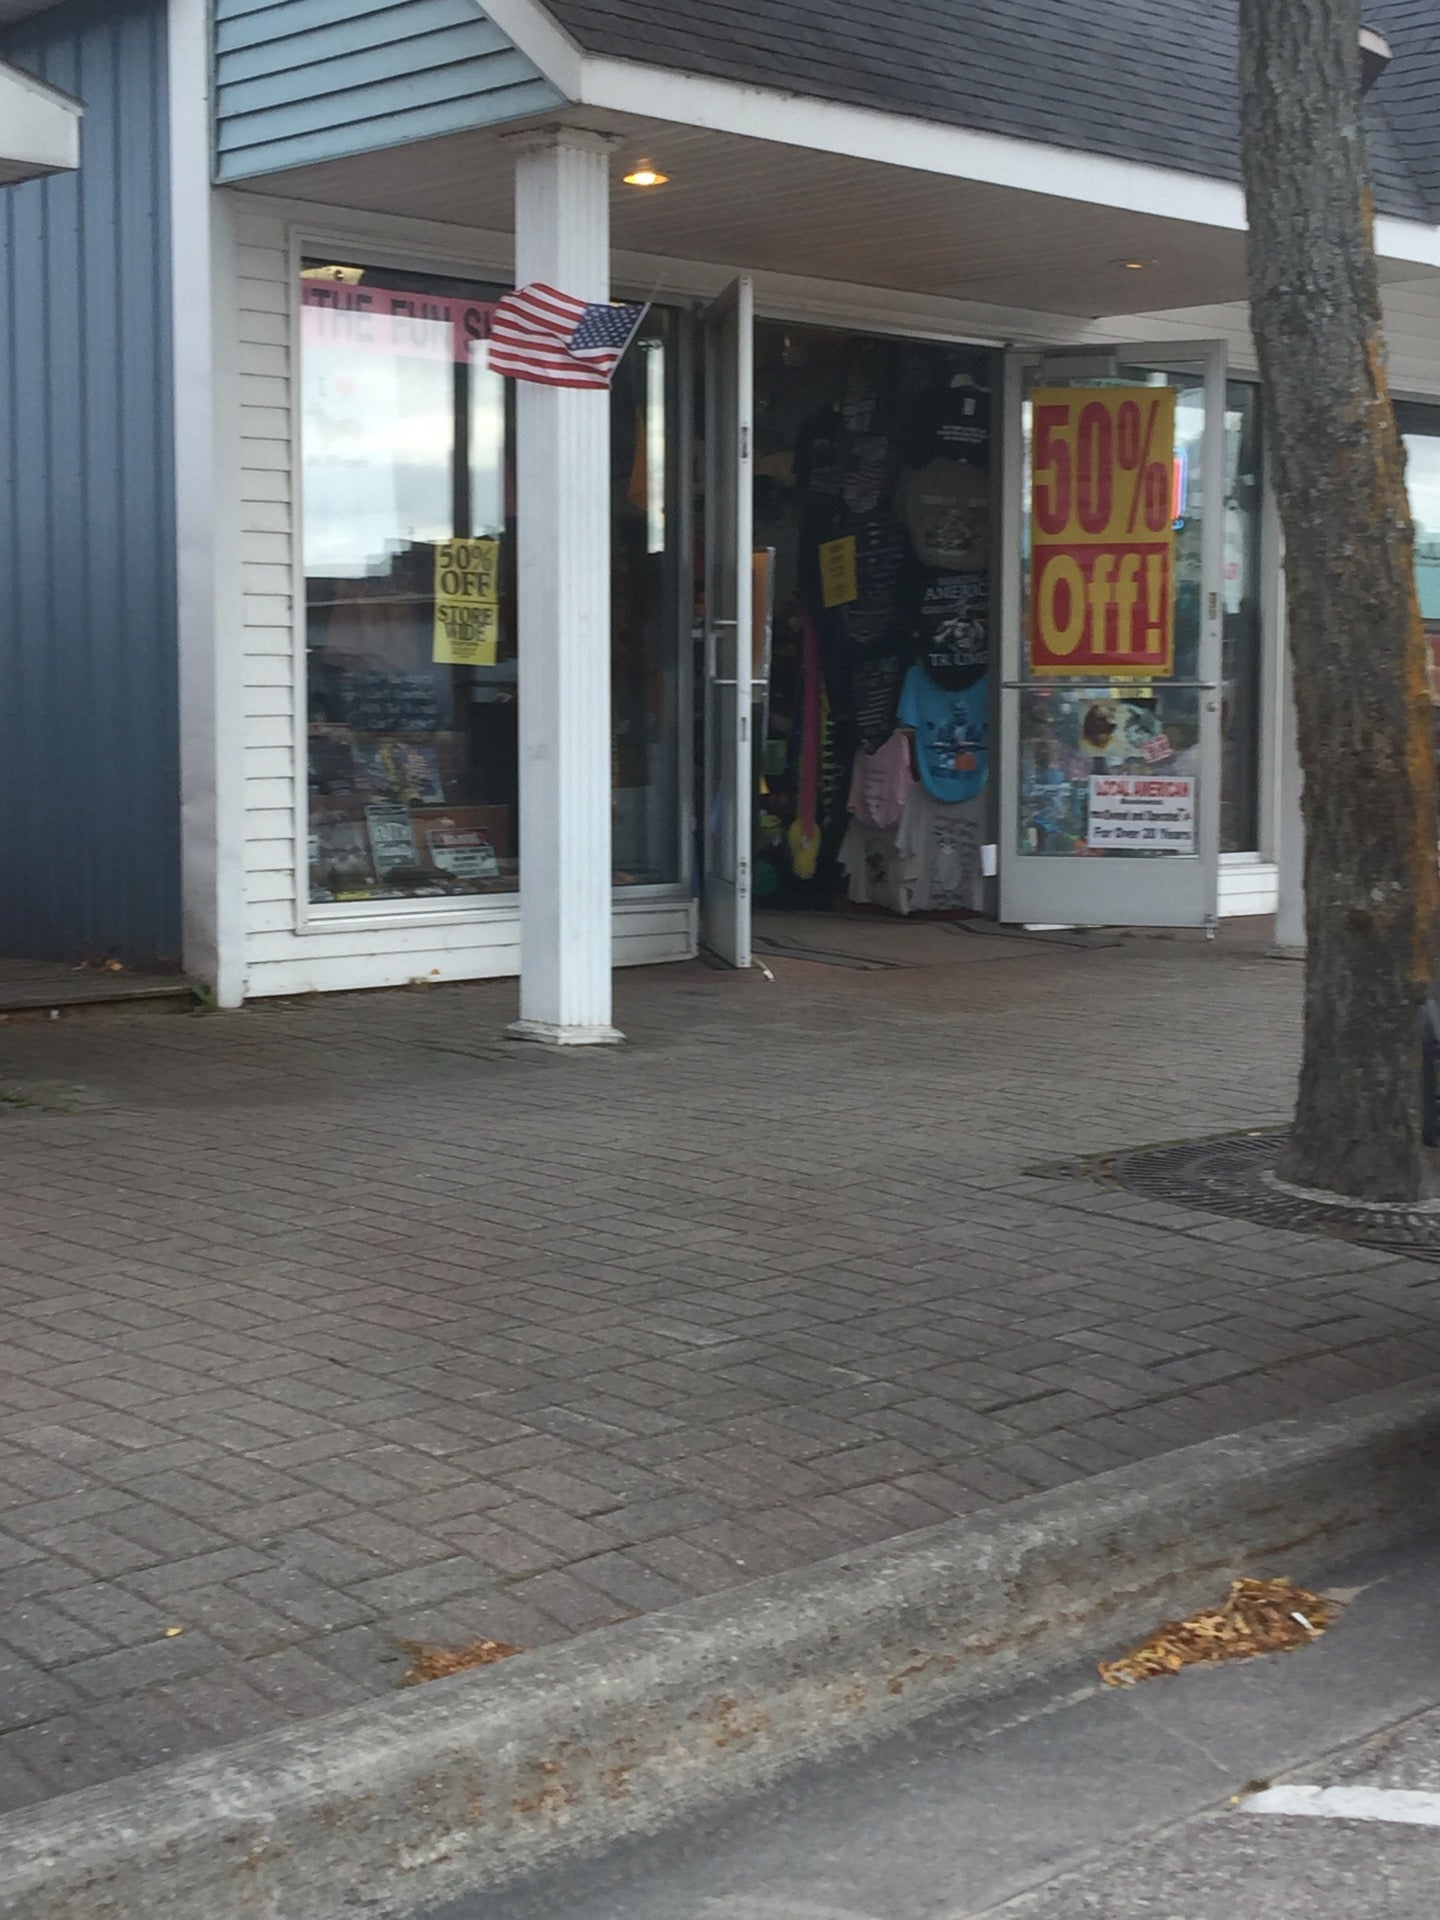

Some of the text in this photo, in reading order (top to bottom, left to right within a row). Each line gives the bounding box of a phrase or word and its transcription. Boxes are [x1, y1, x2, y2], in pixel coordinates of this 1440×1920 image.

[390, 297, 452, 351] FUN
[1034, 399, 1168, 535] 50%
[439, 543, 494, 572] 50%
[440, 569, 491, 597] OFF
[437, 604, 494, 626] STORE
[1038, 553, 1164, 657] Off!
[444, 622, 488, 643] WIDE
